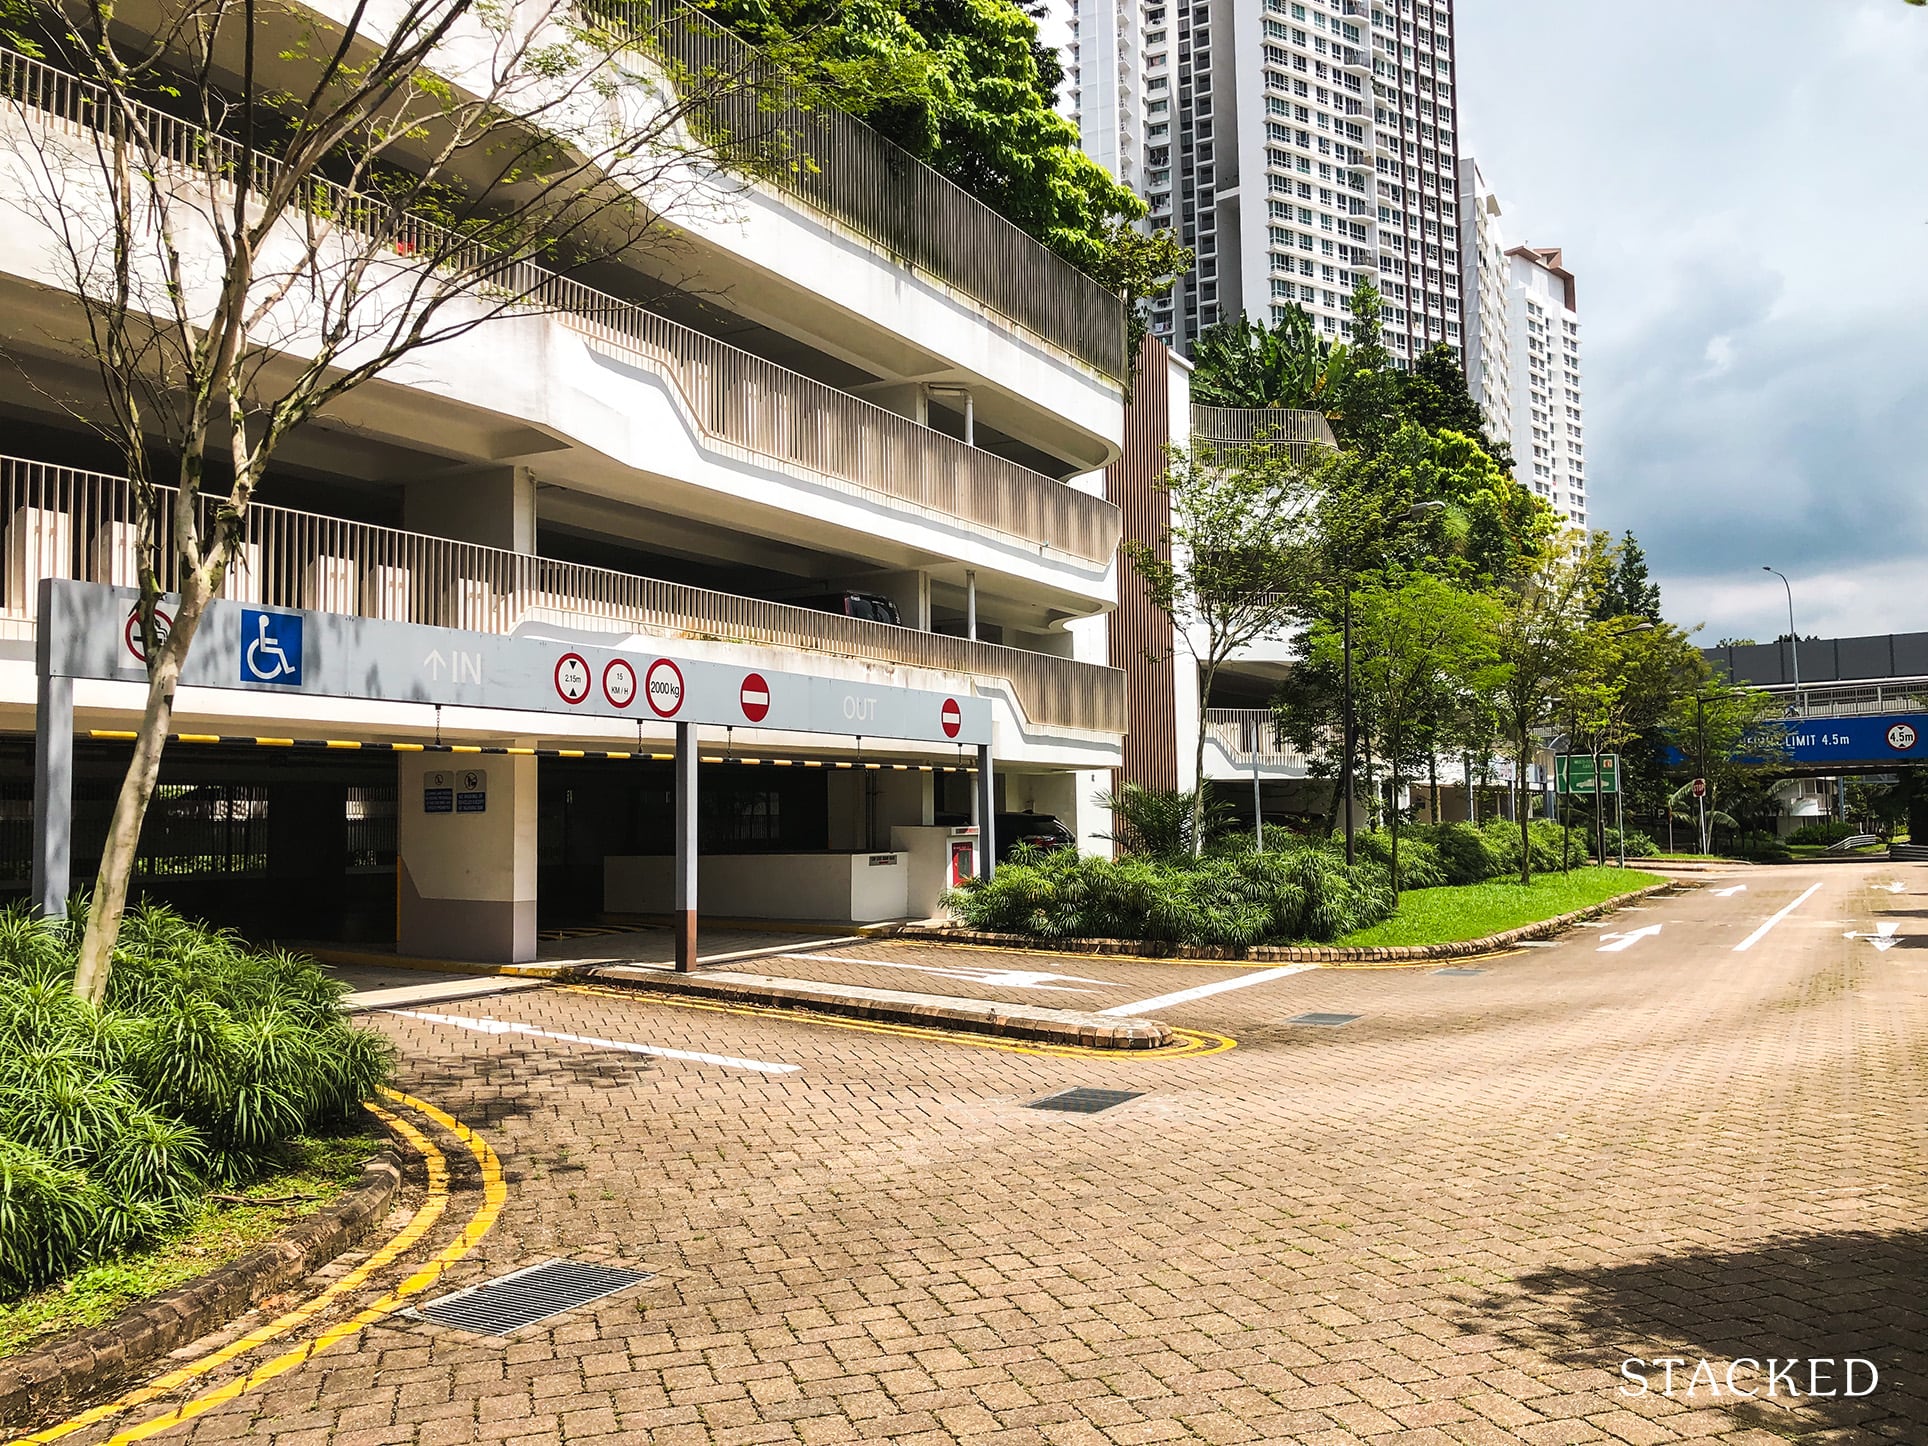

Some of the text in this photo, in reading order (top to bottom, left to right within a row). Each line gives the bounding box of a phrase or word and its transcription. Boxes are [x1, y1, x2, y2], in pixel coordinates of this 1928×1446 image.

[452, 650, 481, 685] IN
[565, 674, 582, 683] 2.15m
[616, 673, 624, 681] 15
[650, 681, 680, 698] 2000 kg
[843, 695, 877, 721] OUT
[1785, 734, 1816, 747] LIMIT
[1821, 733, 1850, 746] 4.5m
[1889, 731, 1914, 742] 4.5m
